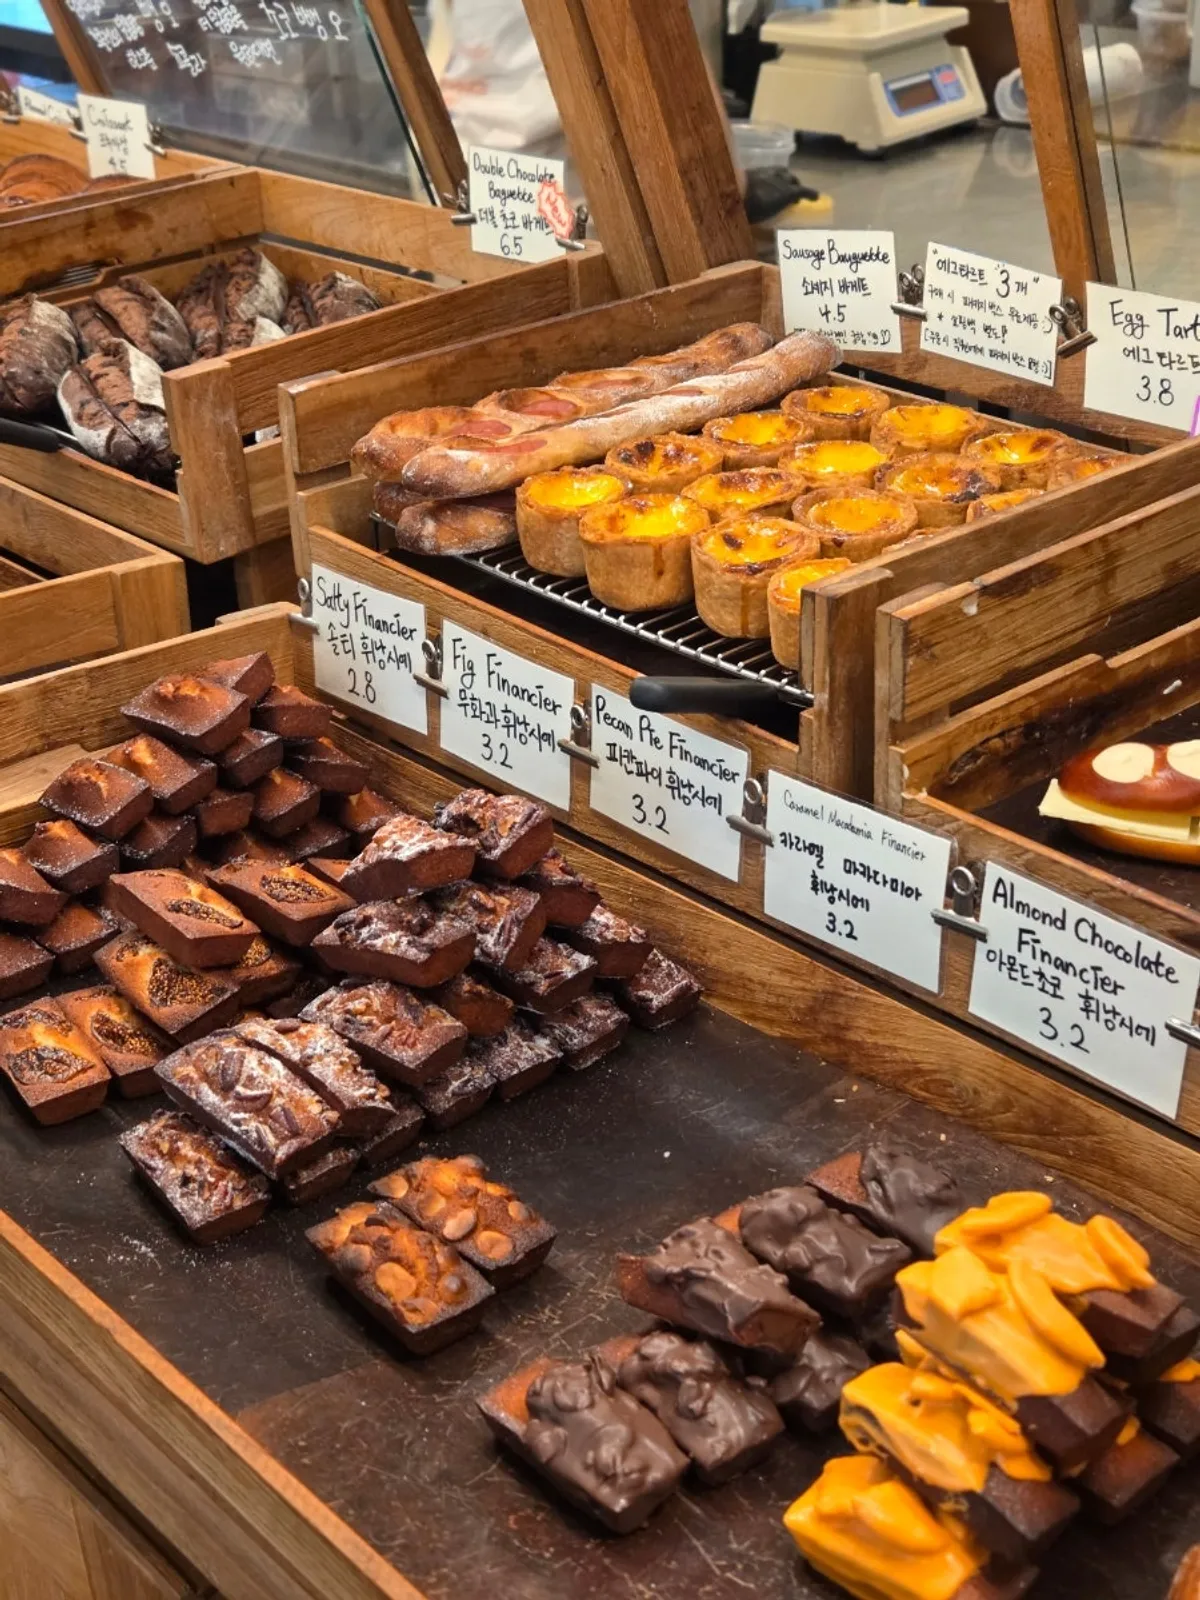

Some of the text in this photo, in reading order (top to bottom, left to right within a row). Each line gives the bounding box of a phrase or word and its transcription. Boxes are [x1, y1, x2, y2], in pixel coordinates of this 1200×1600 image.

[473, 152, 505, 178] Double
[500, 234, 523, 256] 6.5
[783, 239, 825, 270] Sausage
[838, 277, 872, 297] 바게트
[819, 303, 847, 323] 4.5
[1109, 299, 1200, 342] Egg Tart
[1136, 375, 1175, 407] 3.8
[316, 576, 417, 641] Salty Financier
[327, 622, 356, 660] 솔티
[347, 668, 376, 704] 2.8
[452, 637, 562, 716] Fig Financier
[481, 733, 513, 770] 3.2
[595, 694, 740, 783] Pecan Pie Financier
[632, 793, 671, 835] 3.2
[783, 789, 824, 826] Caramel
[881, 827, 928, 862] Financier
[810, 870, 870, 912] 휘낭시에
[842, 858, 923, 902] 마카다미아
[825, 912, 859, 942] 3.2
[992, 877, 1180, 985] Almond Chocolate
[1017, 927, 1126, 996] Financier
[1038, 1007, 1091, 1055] 3.2
[1077, 988, 1157, 1047] 휘낭시에
